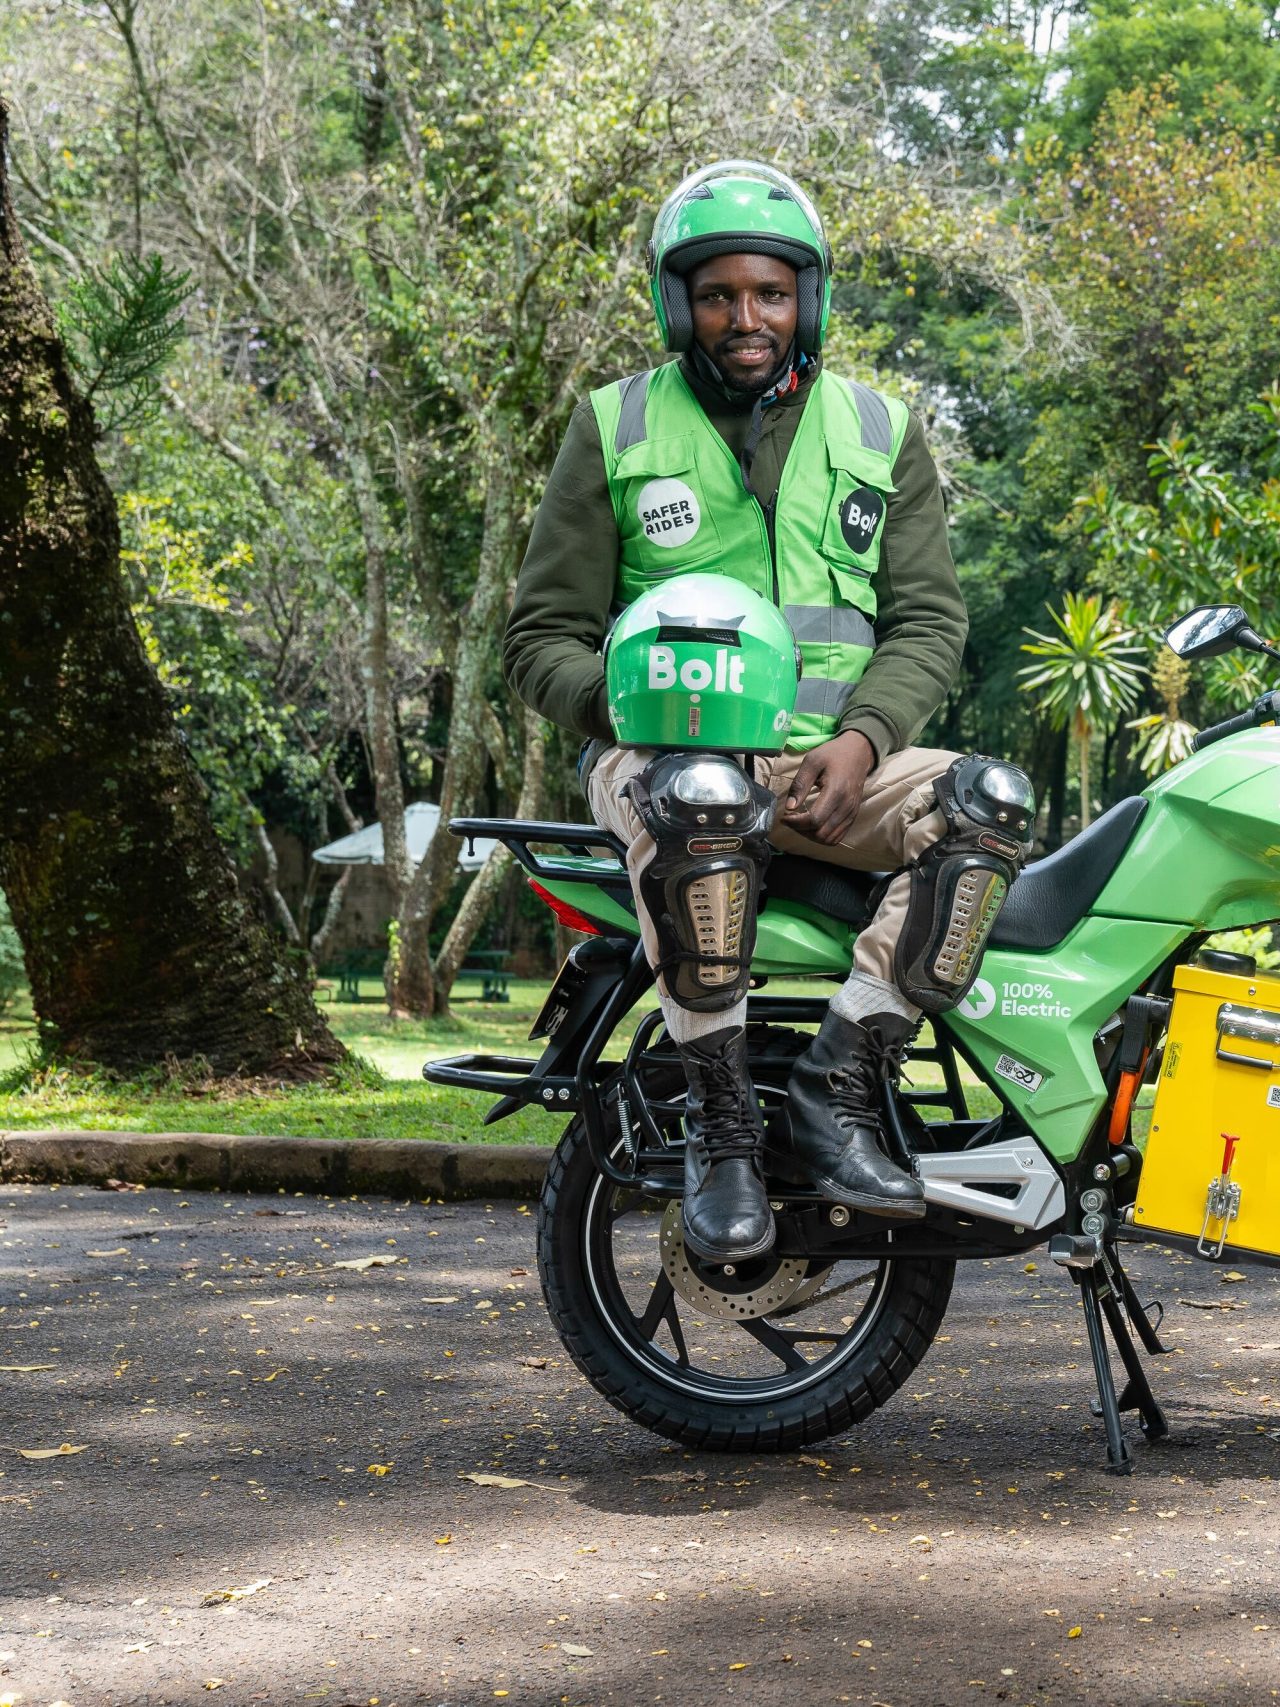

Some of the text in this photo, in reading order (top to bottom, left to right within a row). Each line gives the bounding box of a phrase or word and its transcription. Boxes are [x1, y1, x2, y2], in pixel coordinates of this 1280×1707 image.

[643, 500, 690, 522] SAFER
[646, 513, 694, 535] RIDES
[649, 645, 745, 703] Bolt
[1002, 983, 1053, 999] 100%
[1001, 1000, 1072, 1018] Electric
